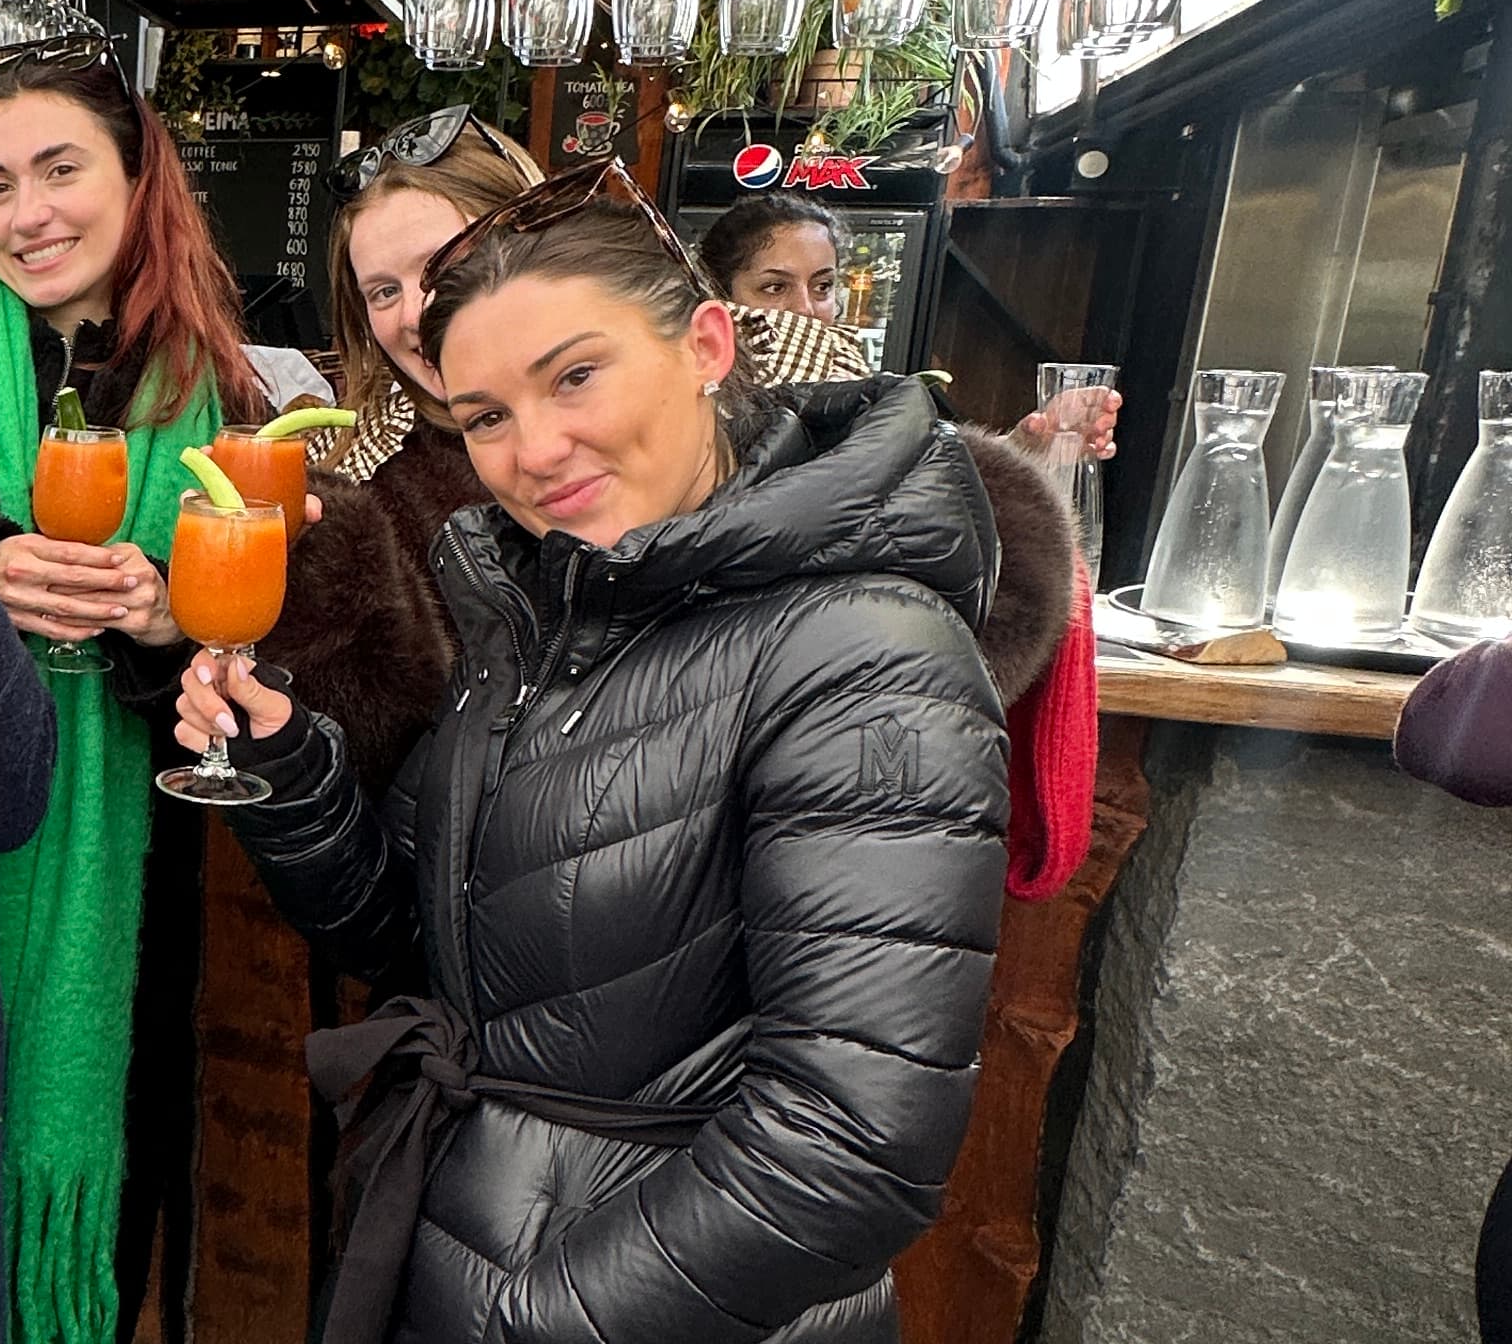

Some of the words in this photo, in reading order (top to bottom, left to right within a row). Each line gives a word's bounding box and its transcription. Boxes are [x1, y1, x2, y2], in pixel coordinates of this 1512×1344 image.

[291, 161, 317, 175] 1580
[782, 156, 881, 190] MAX
[289, 178, 310, 192] 670
[288, 192, 310, 206] 750
[288, 207, 307, 220] 870
[286, 238, 308, 256] 600
[276, 261, 305, 277] 1680
